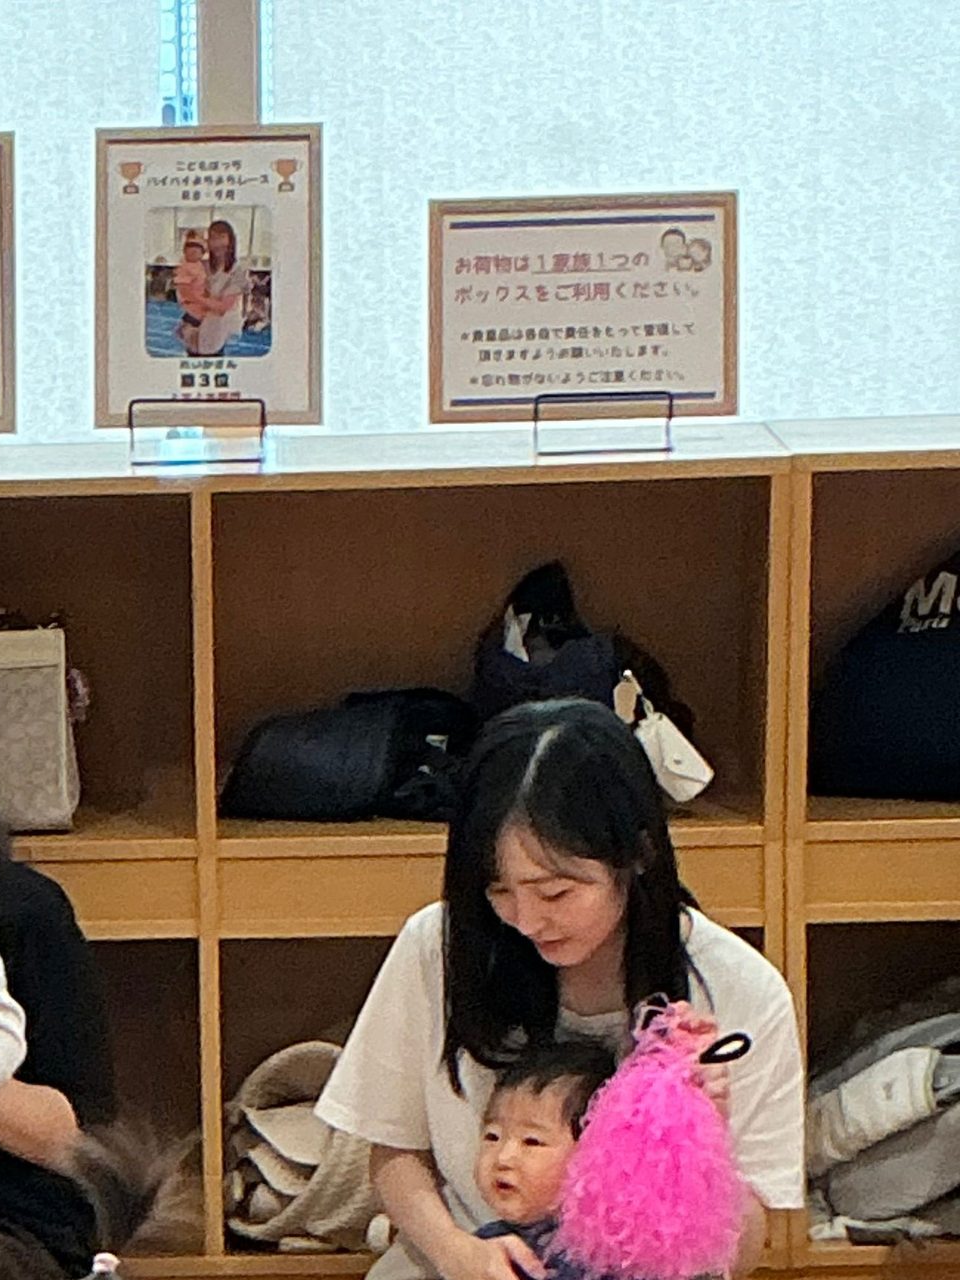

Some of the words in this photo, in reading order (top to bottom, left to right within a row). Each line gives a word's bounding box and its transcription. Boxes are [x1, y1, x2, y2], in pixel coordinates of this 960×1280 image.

[455, 281, 699, 304] ボックスをご利用ください。
[181, 373, 229, 388] 第3位
